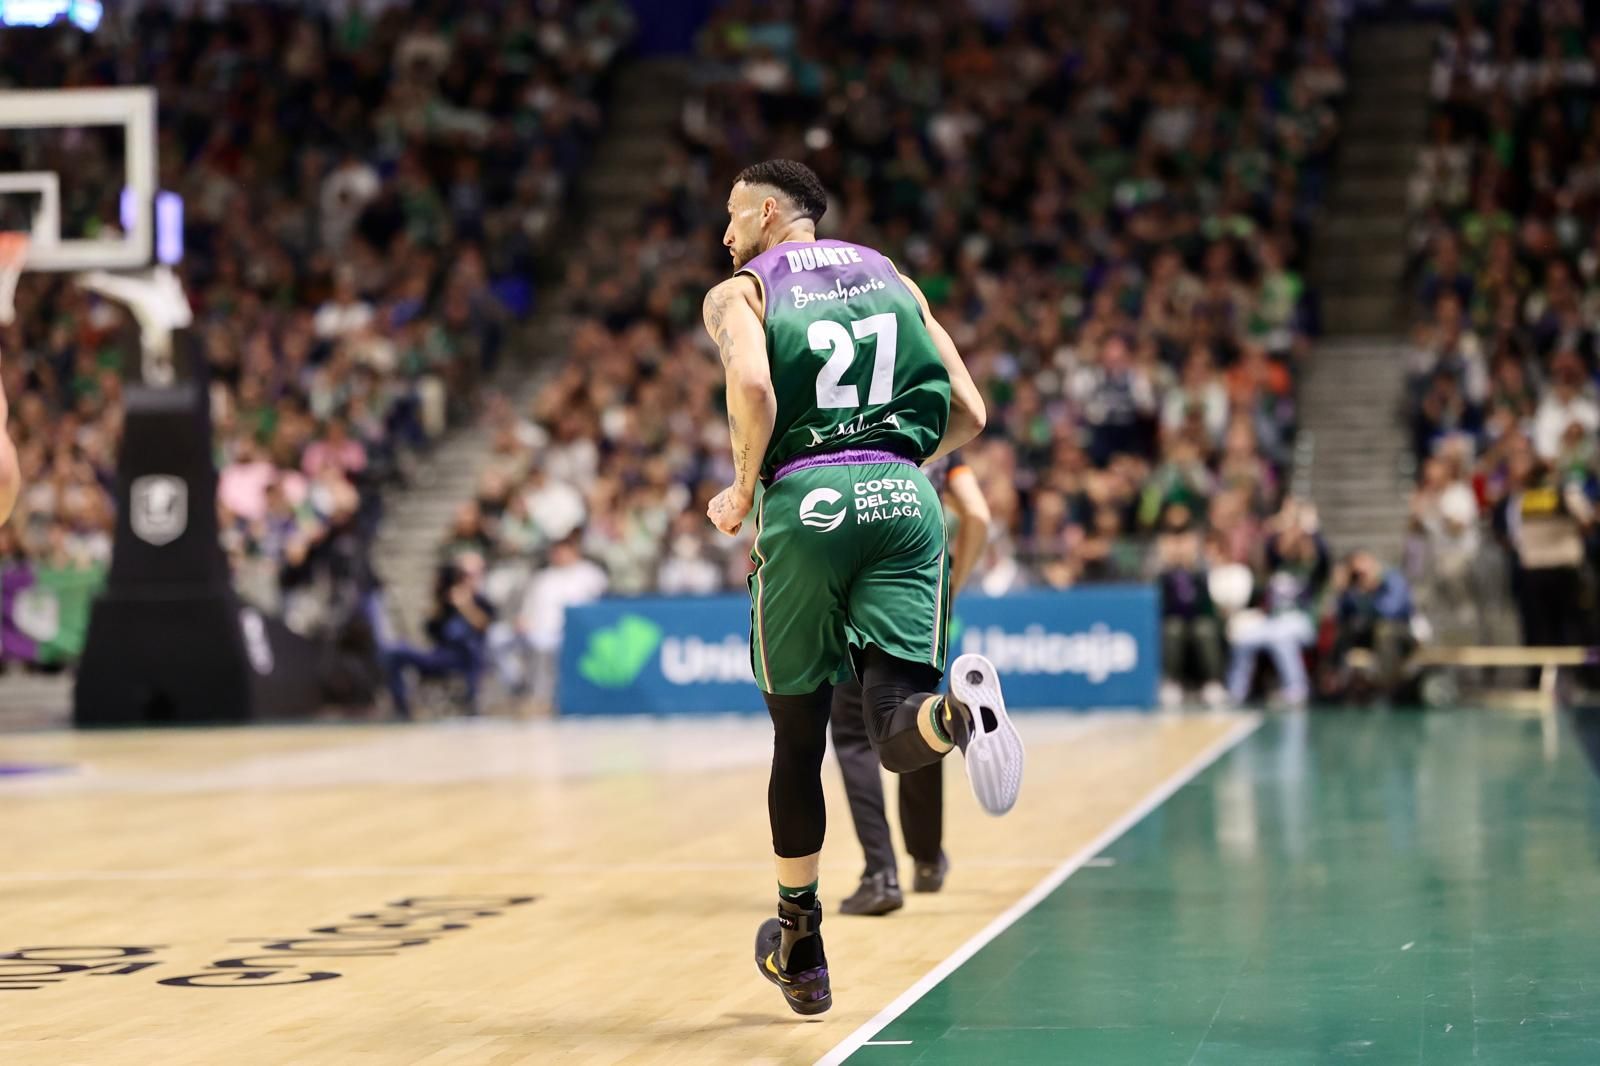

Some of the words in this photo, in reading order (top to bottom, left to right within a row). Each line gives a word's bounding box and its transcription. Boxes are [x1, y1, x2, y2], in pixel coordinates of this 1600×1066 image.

[786, 247, 863, 273] DUARTE
[807, 312, 898, 409] 27
[854, 478, 919, 495] COSTA
[854, 494, 888, 510] DEL
[890, 491, 922, 506] SOL
[857, 505, 922, 525] MÁLAGA
[962, 621, 1138, 684] Unicaja
